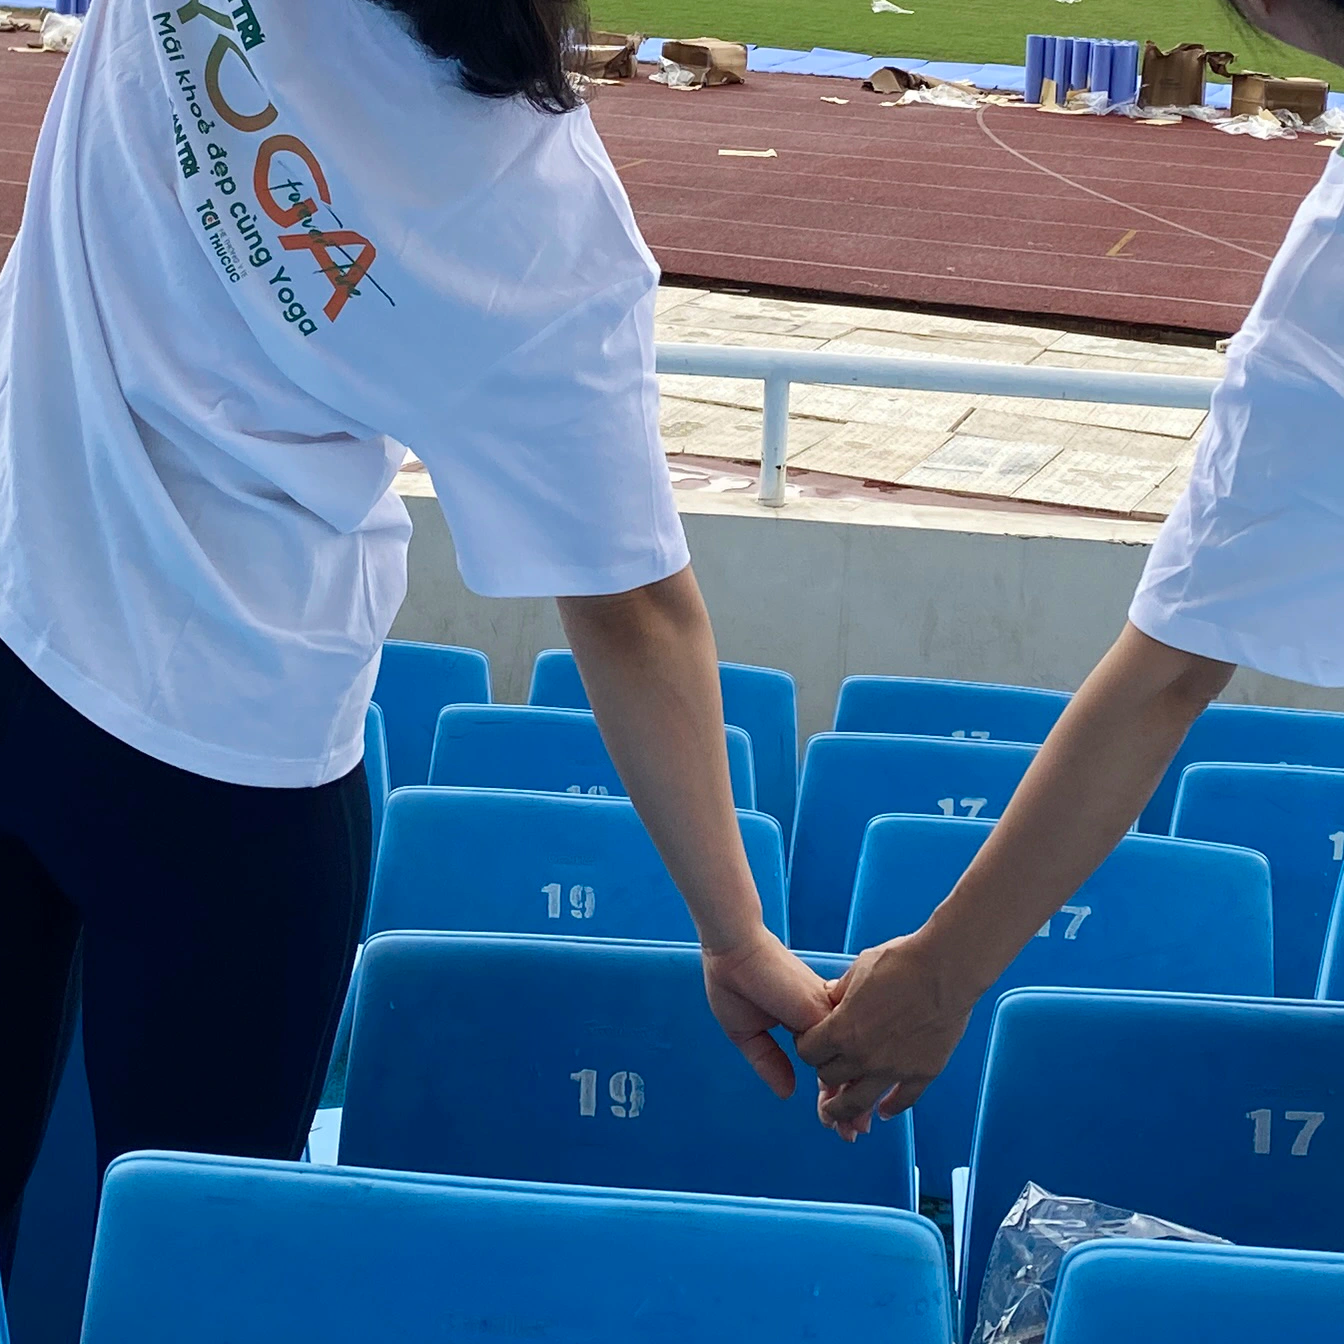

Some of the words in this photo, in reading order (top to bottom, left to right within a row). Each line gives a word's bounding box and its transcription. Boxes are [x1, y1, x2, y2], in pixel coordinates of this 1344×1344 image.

[152, 11, 185, 62] Mãi
[175, 69, 216, 135] khoẻ
[206, 143, 237, 196] đẹp
[229, 201, 273, 268] cùng
[268, 265, 319, 337] Yoga
[539, 882, 596, 922] 19
[569, 1067, 646, 1121] 19
[1246, 1106, 1327, 1158] 17
